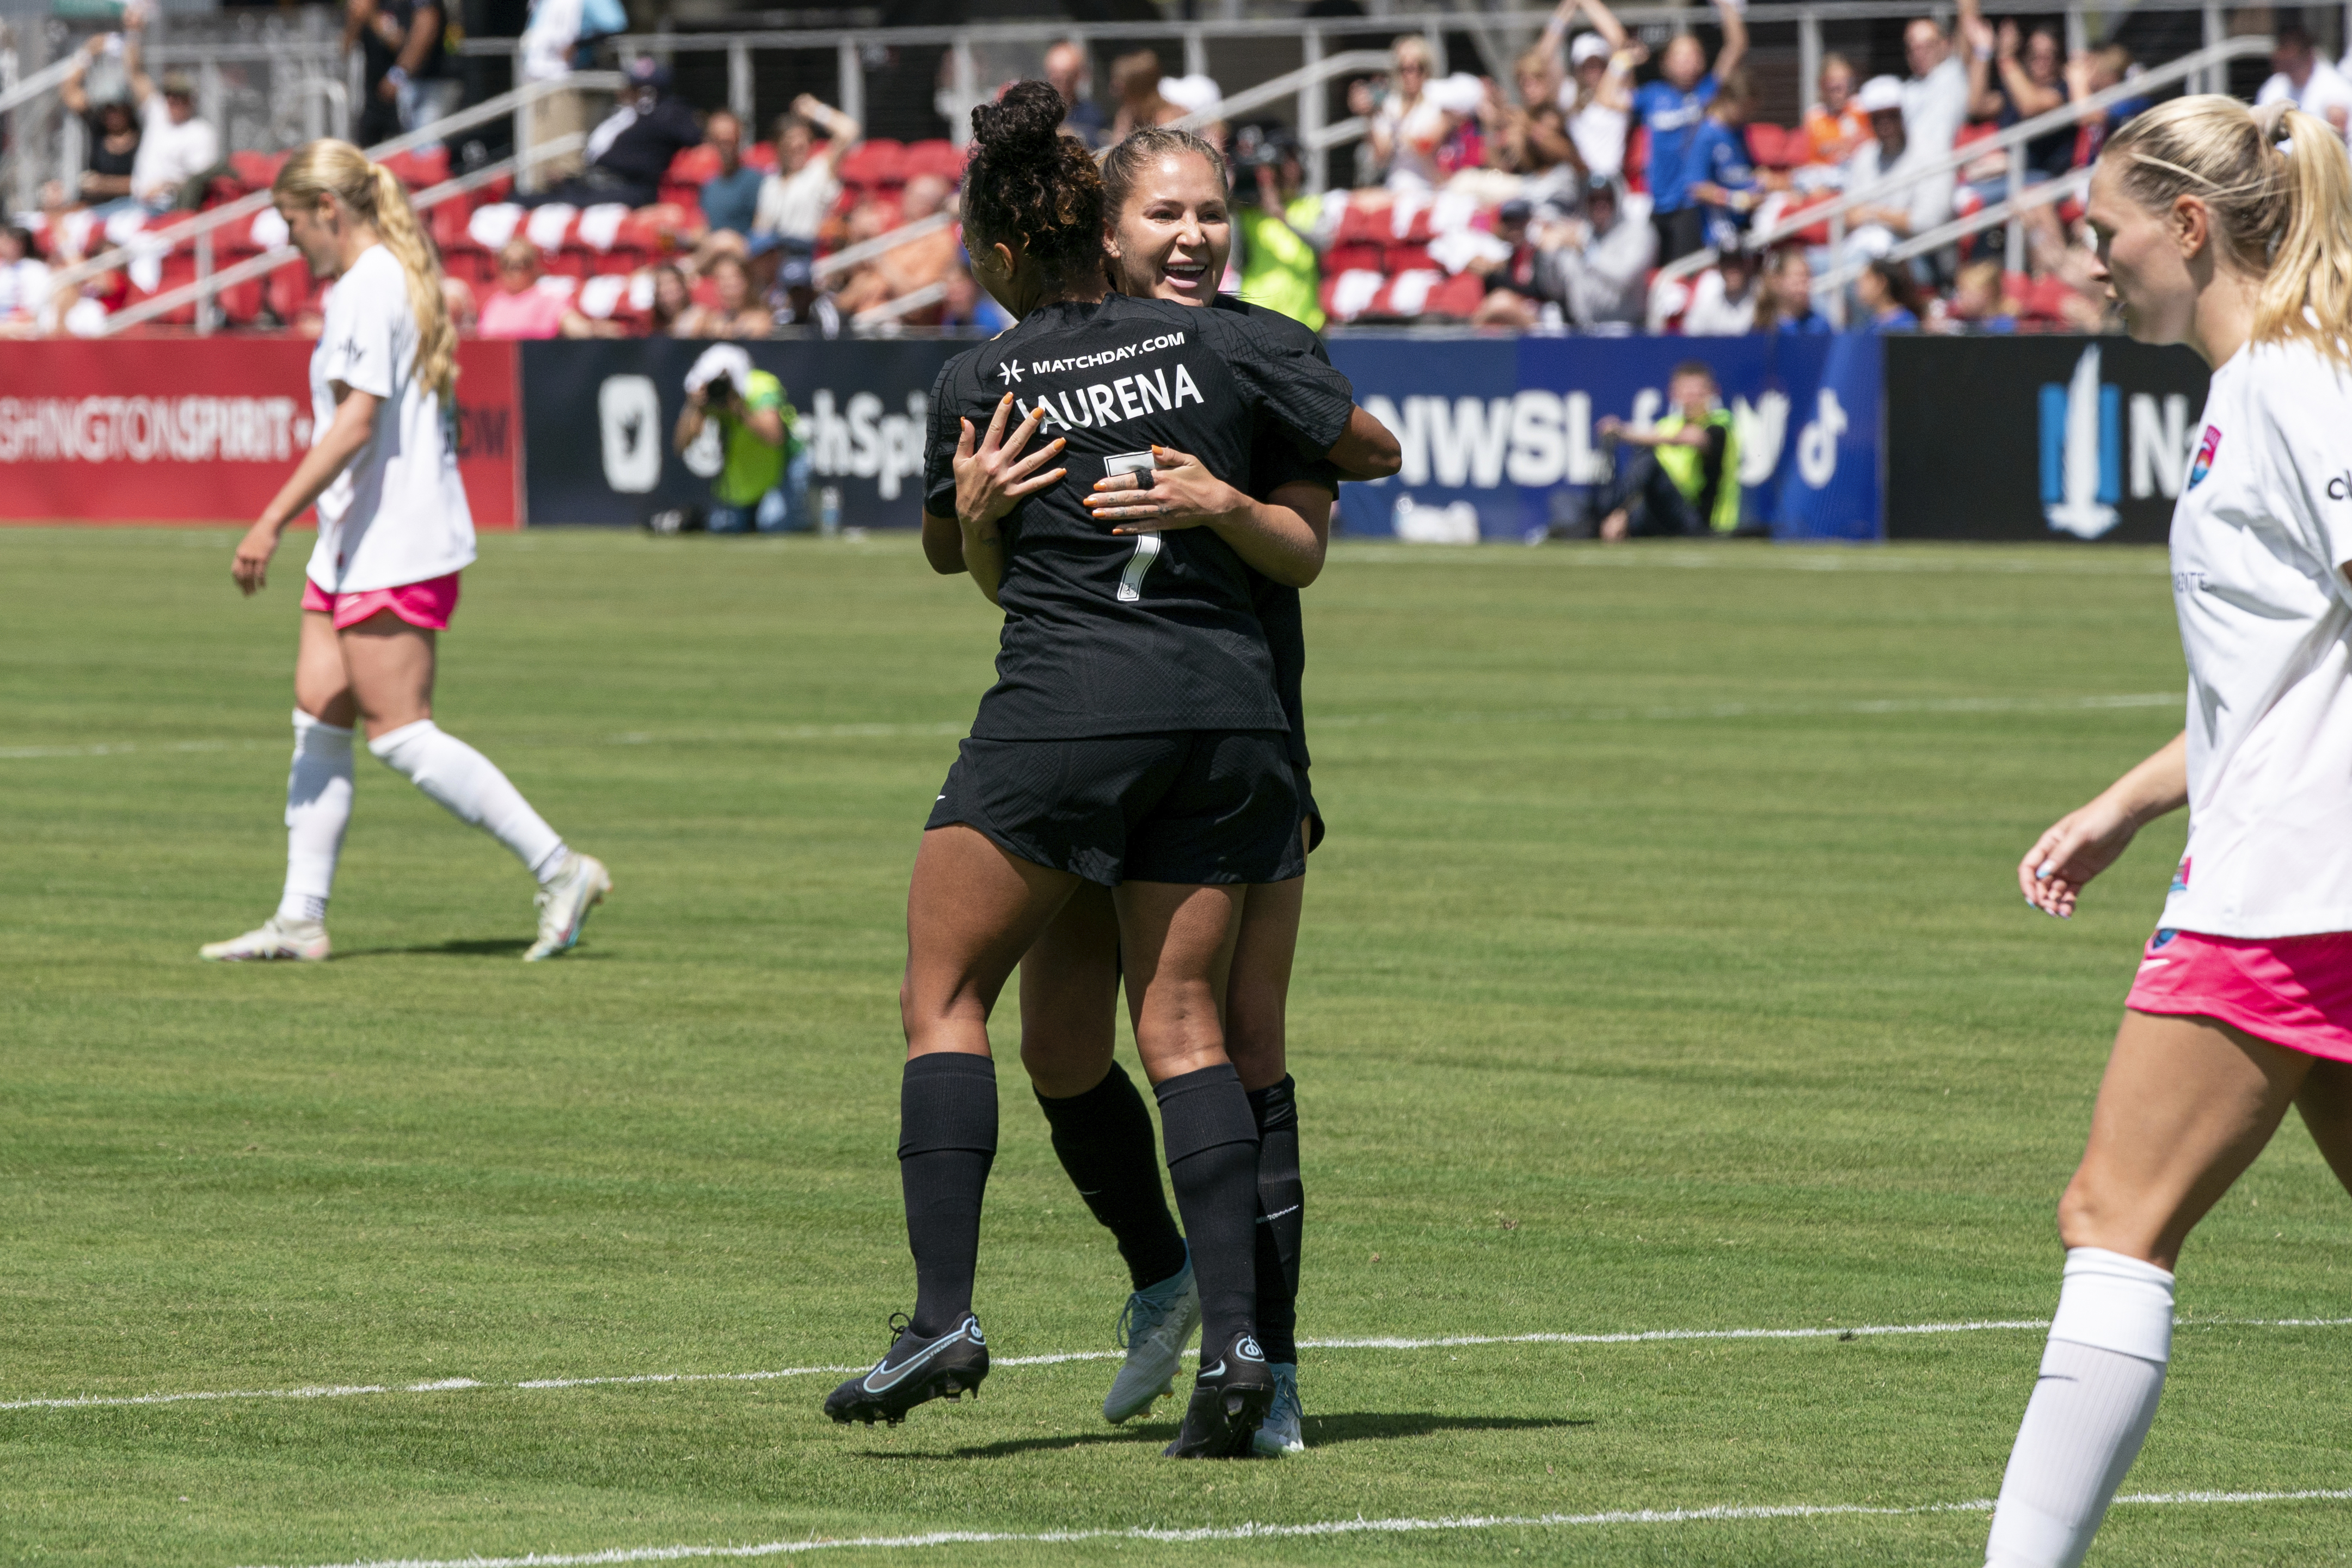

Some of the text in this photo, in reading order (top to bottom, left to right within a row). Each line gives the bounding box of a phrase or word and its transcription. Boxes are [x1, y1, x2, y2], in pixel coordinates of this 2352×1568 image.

[1032, 331, 1185, 374] MATCHDAY.COM
[2129, 392, 2200, 500] N
[1103, 448, 1162, 602] 7
